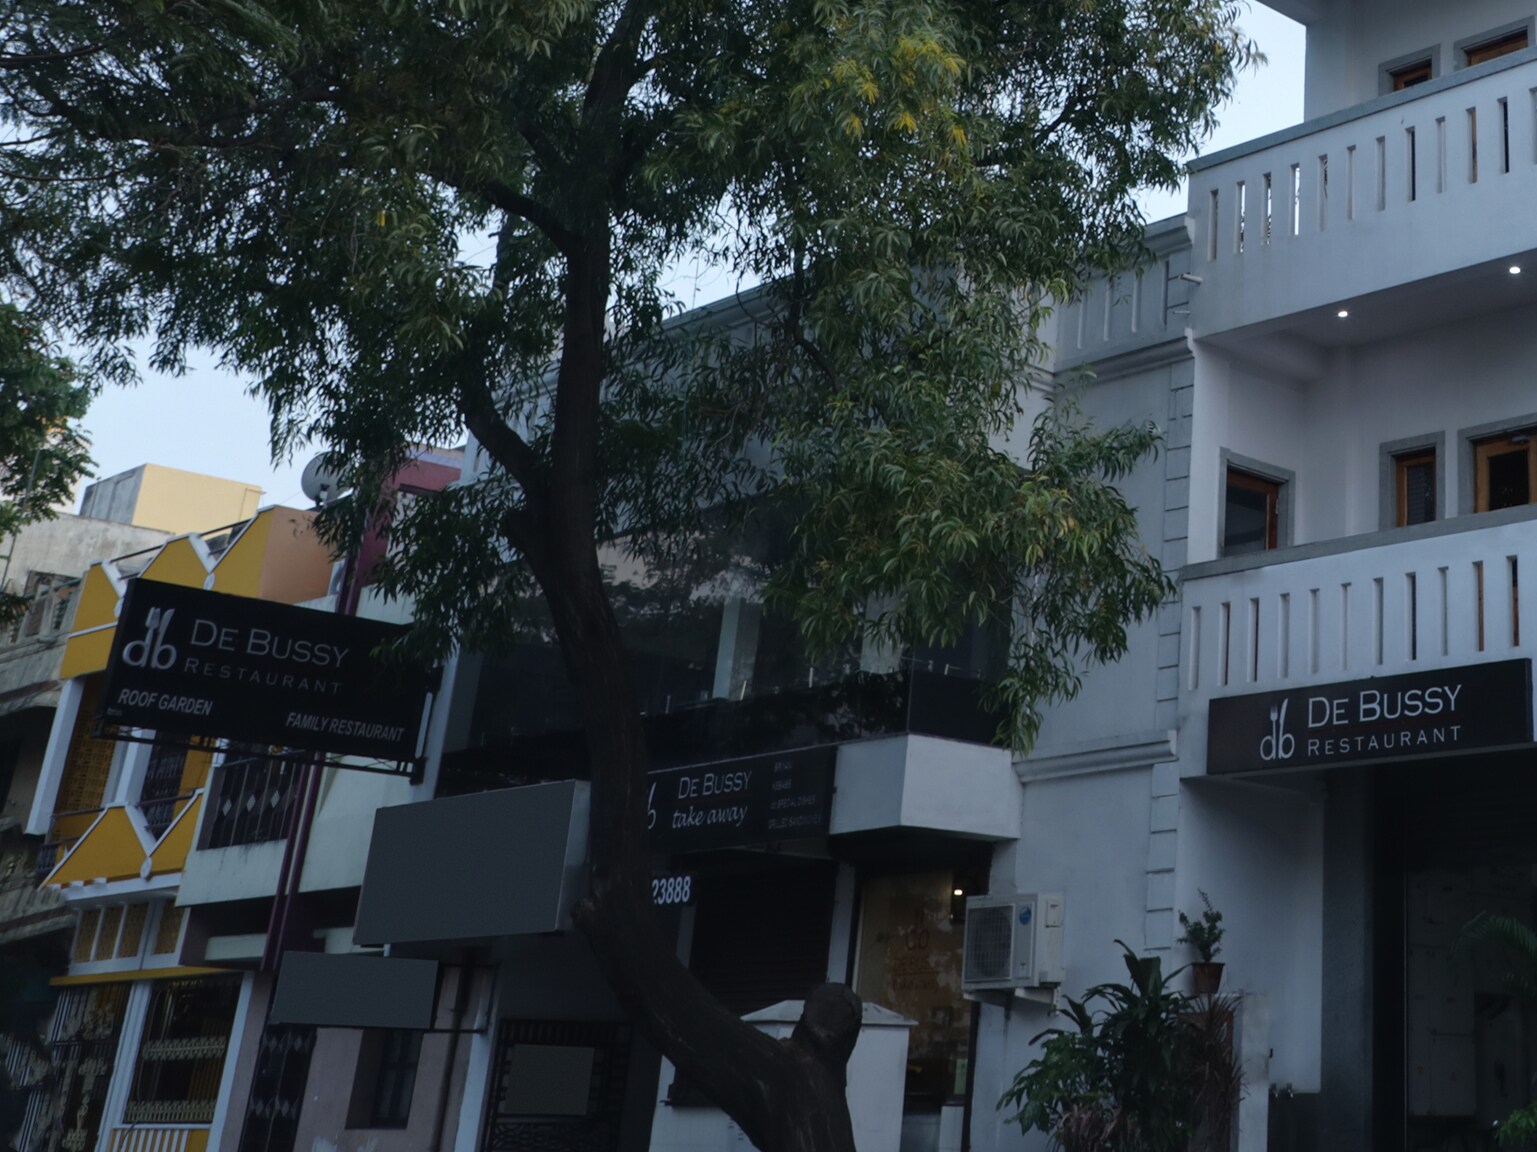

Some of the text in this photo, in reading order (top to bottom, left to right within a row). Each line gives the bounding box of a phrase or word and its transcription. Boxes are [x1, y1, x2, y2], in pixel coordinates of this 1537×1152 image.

[190, 619, 349, 669] DE BUSSY
[184, 657, 343, 695] RESTAURANT
[118, 688, 213, 716] ROOF GARDEN
[1308, 684, 1463, 729] DE BUSSY
[285, 712, 405, 743] FAMILY RESTAURANT
[1308, 725, 1462, 757] RESTAURANT
[677, 776, 700, 799] DE
[702, 770, 753, 796] BUSSY
[671, 806, 705, 829] take
[707, 804, 748, 828] away
